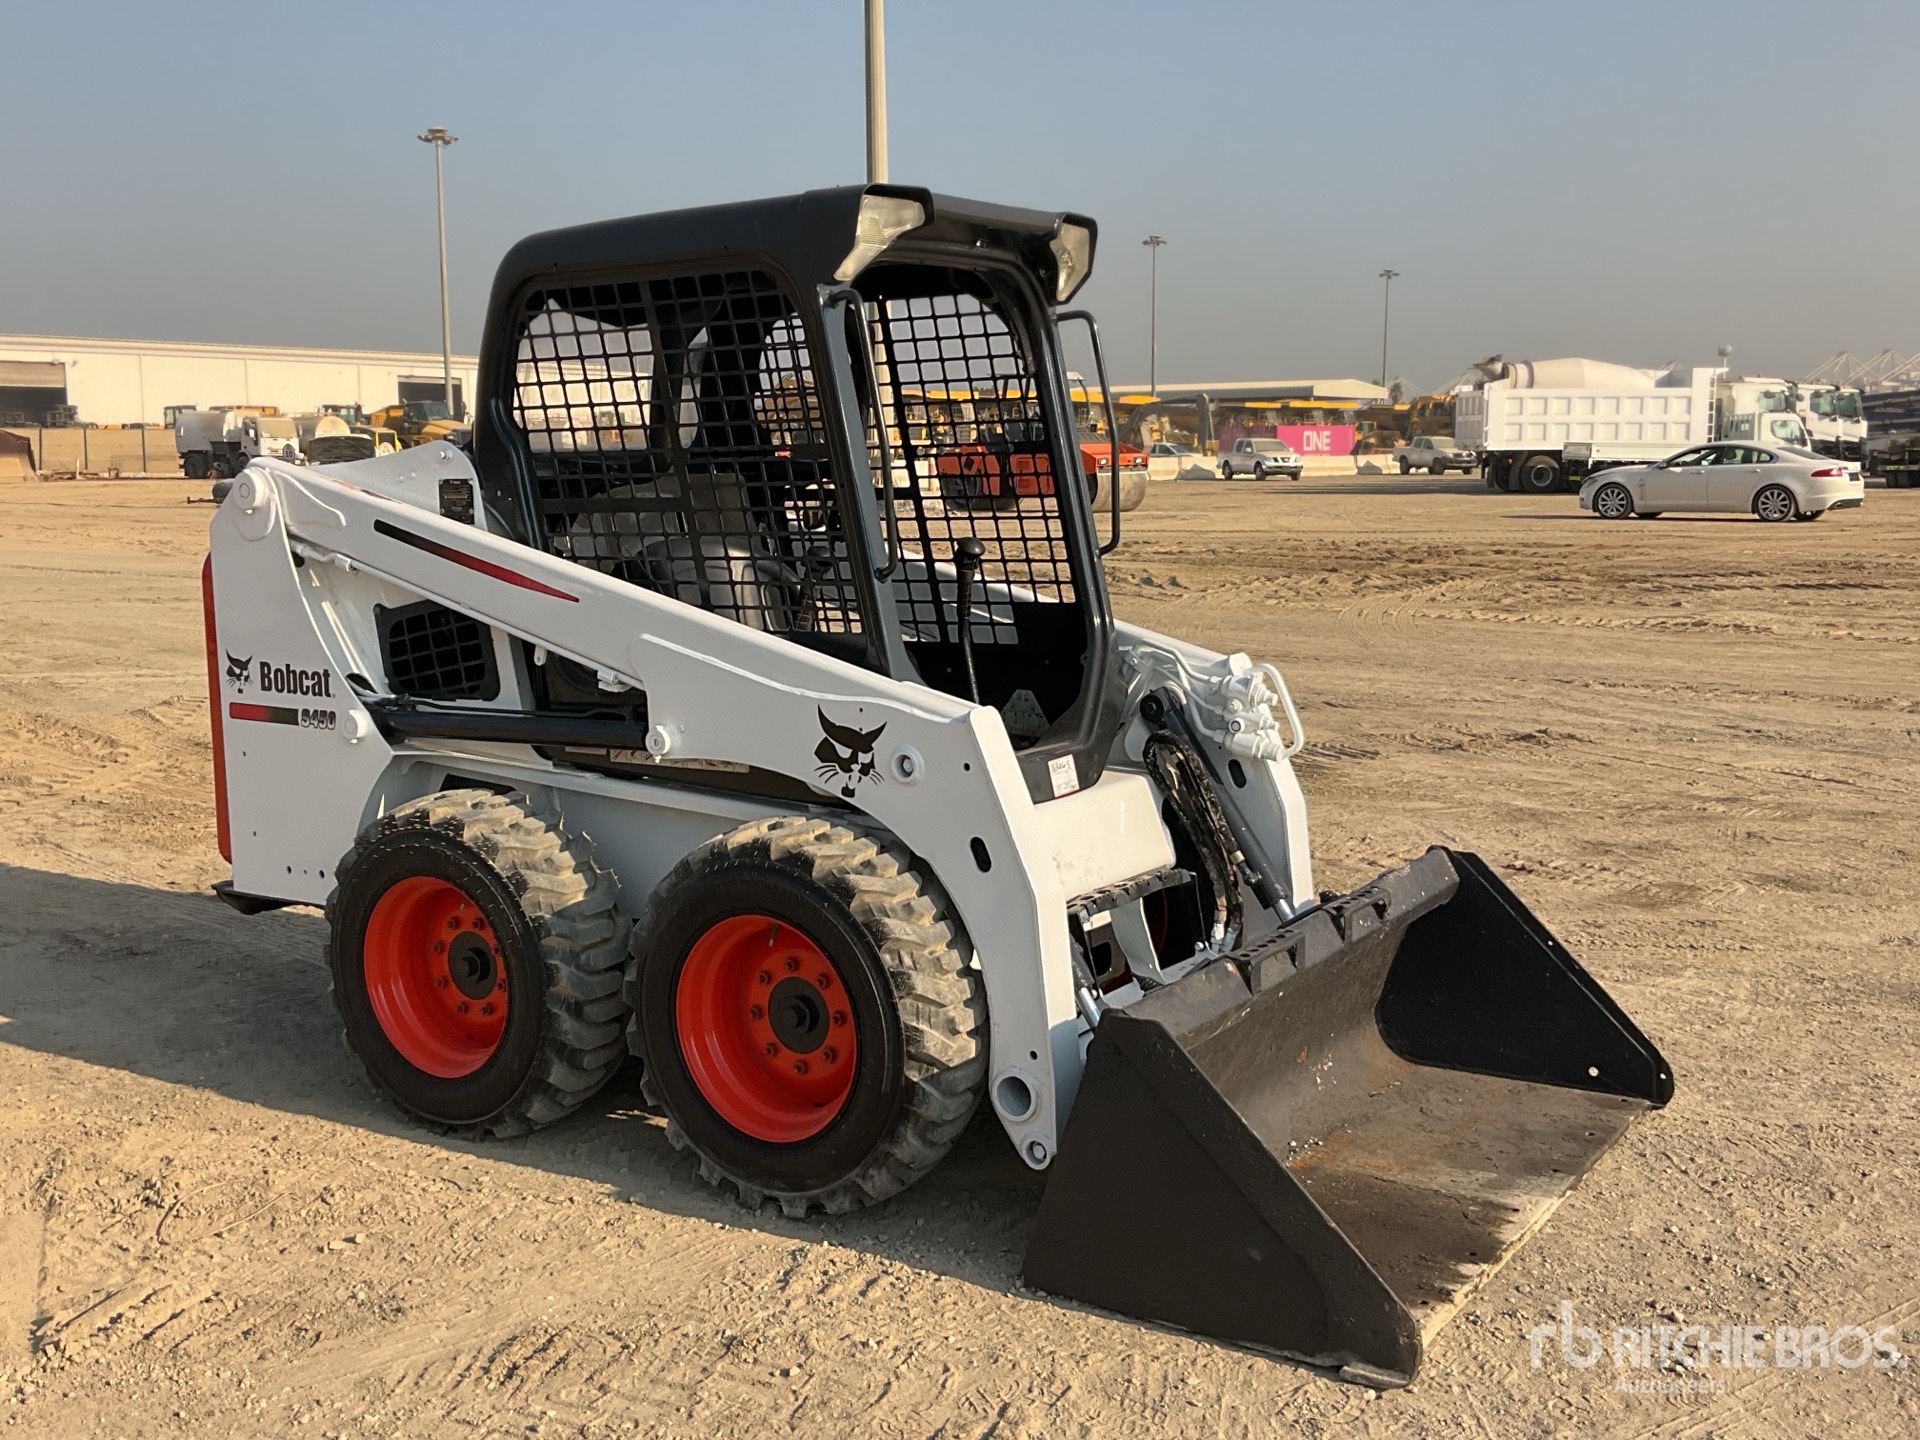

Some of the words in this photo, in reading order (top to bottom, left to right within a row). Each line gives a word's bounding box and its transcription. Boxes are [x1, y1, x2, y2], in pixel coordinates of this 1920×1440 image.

[1303, 431, 1331, 451] ONE
[260, 661, 331, 698] Bobcat
[301, 708, 336, 730] S450
